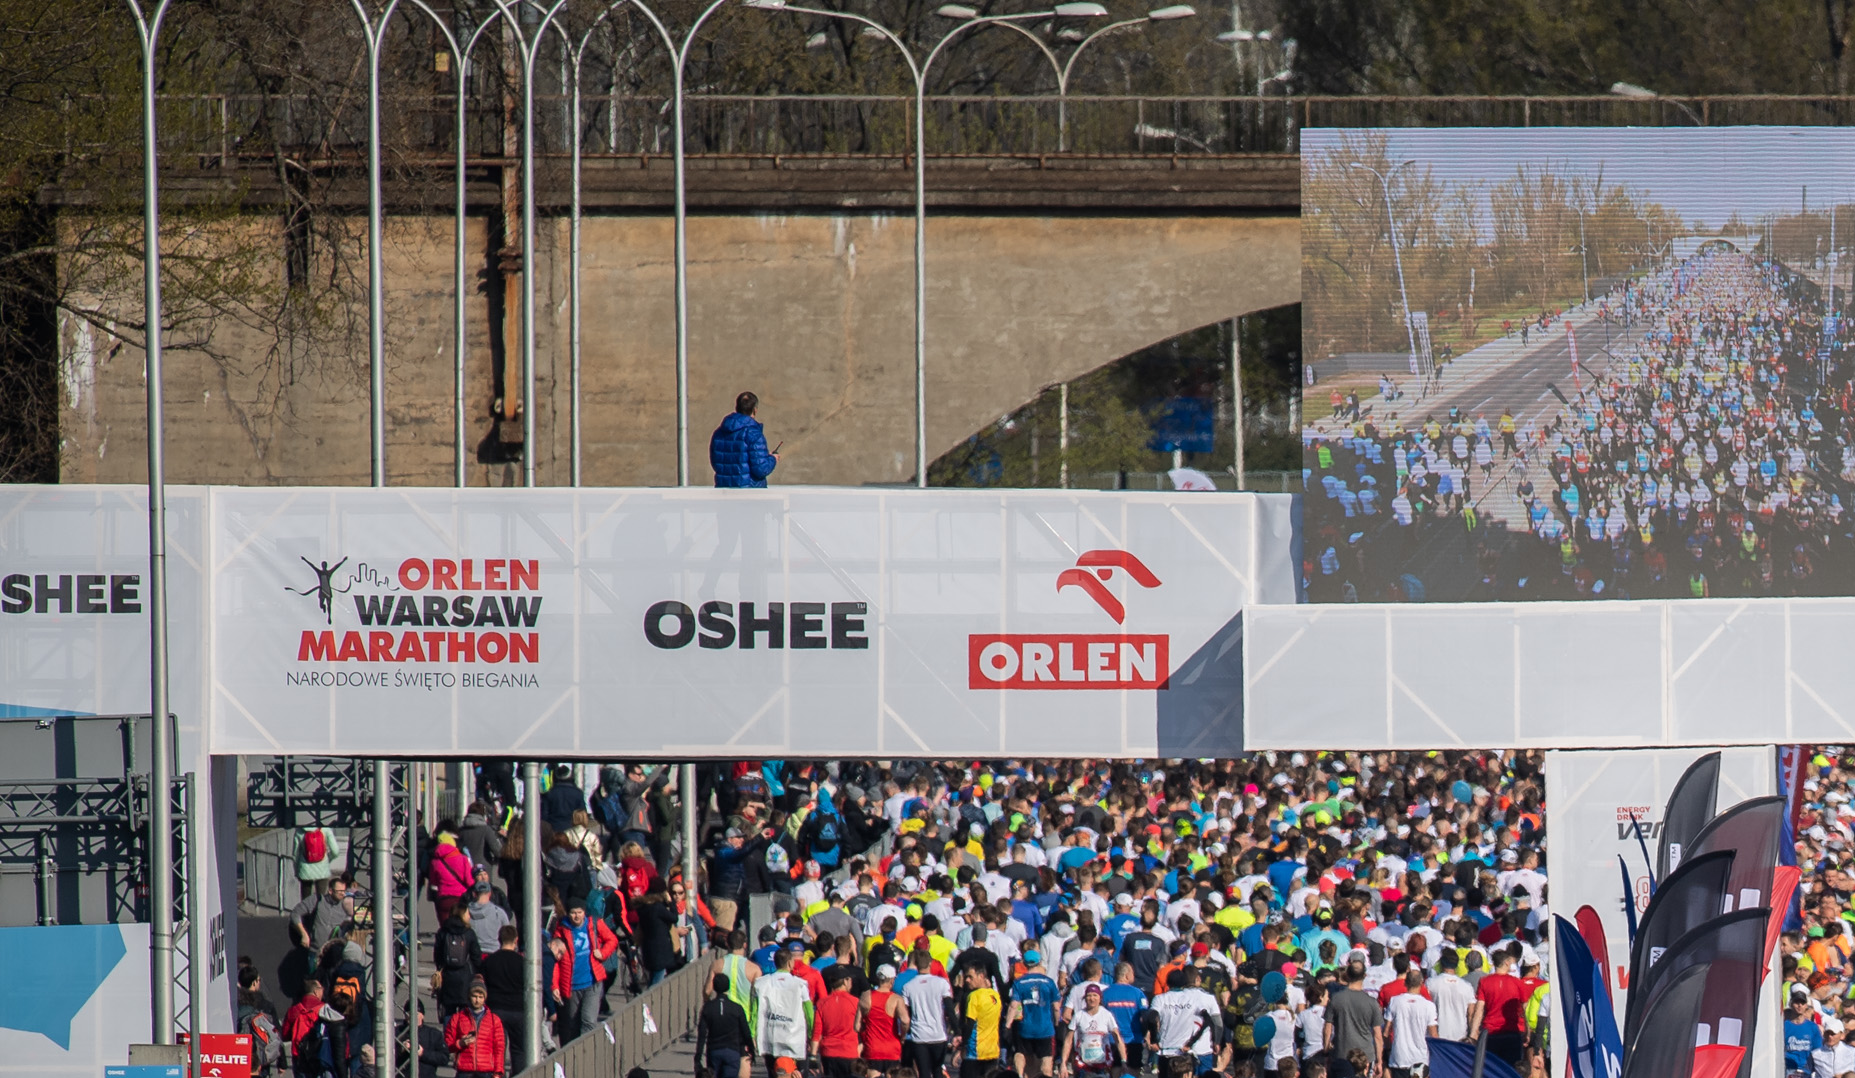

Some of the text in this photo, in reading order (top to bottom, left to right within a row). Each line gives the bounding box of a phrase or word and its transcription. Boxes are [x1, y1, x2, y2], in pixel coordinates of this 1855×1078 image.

[398, 558, 540, 591] ORLEN
[1, 574, 142, 614] SHEE
[353, 595, 543, 627] WARSAW
[644, 601, 869, 649] OSHEE
[297, 631, 540, 663] MARATHON
[979, 642, 1156, 682] ORLEN
[287, 667, 540, 691] NARODOWE ŚWIĘTO BIEGANIA
